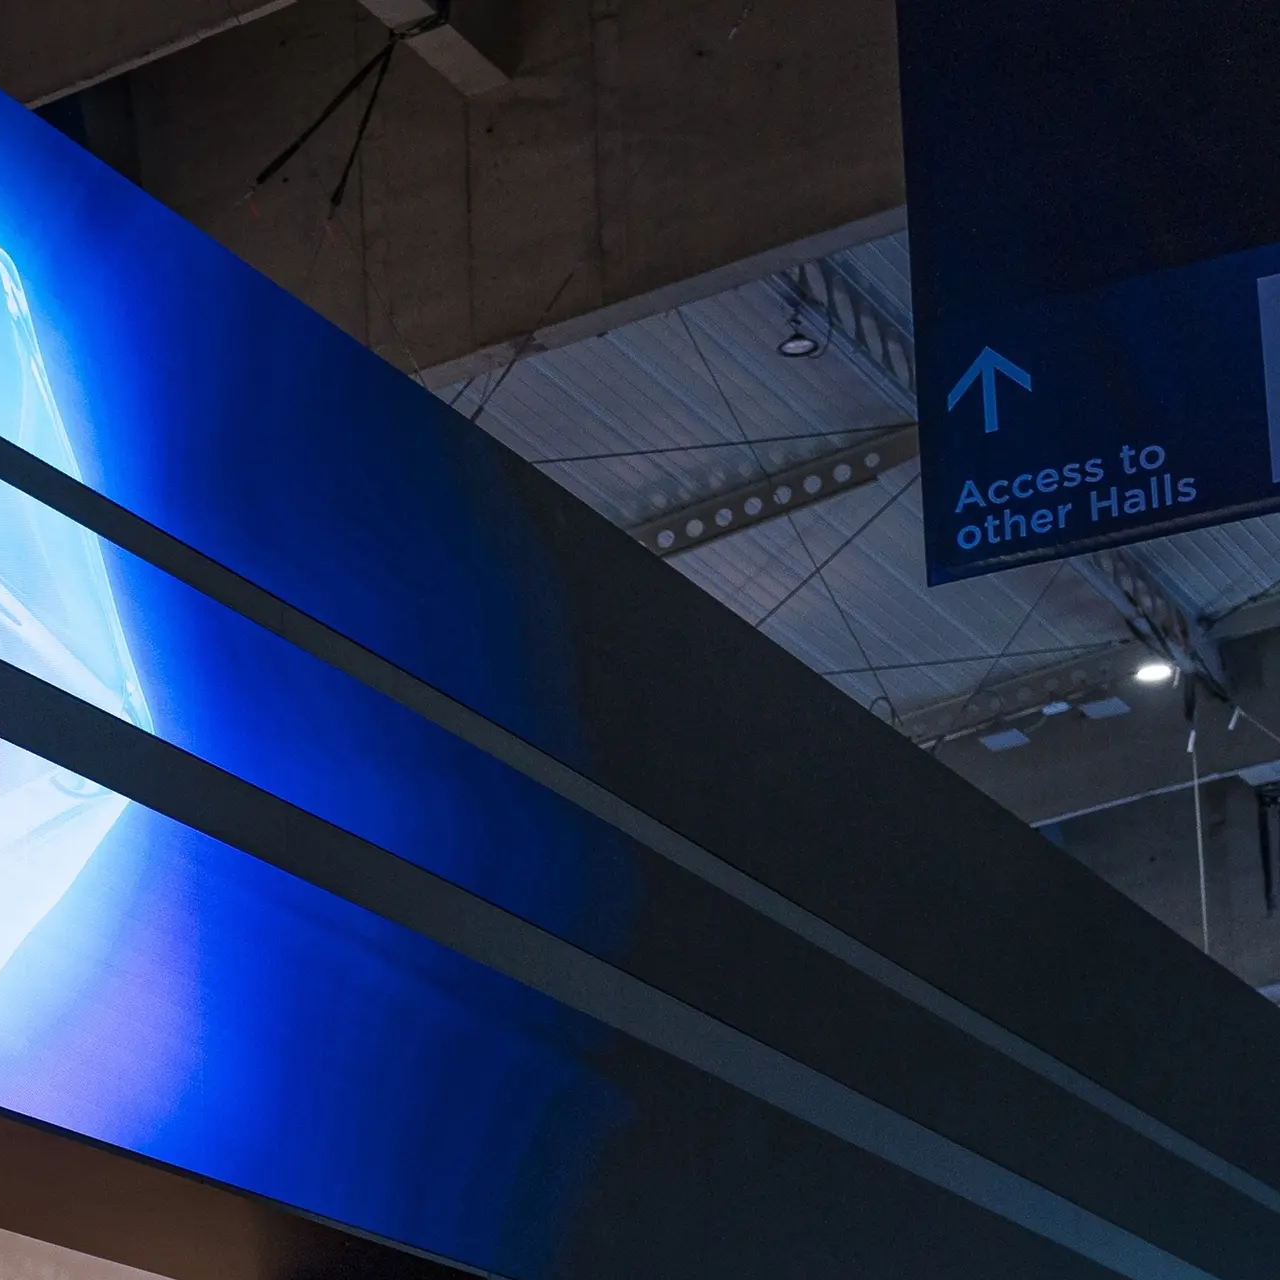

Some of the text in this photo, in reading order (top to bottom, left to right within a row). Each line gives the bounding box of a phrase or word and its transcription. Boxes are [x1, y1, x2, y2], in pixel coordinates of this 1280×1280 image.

[955, 444, 1165, 513] Access to
[957, 474, 1197, 549] other Halls
